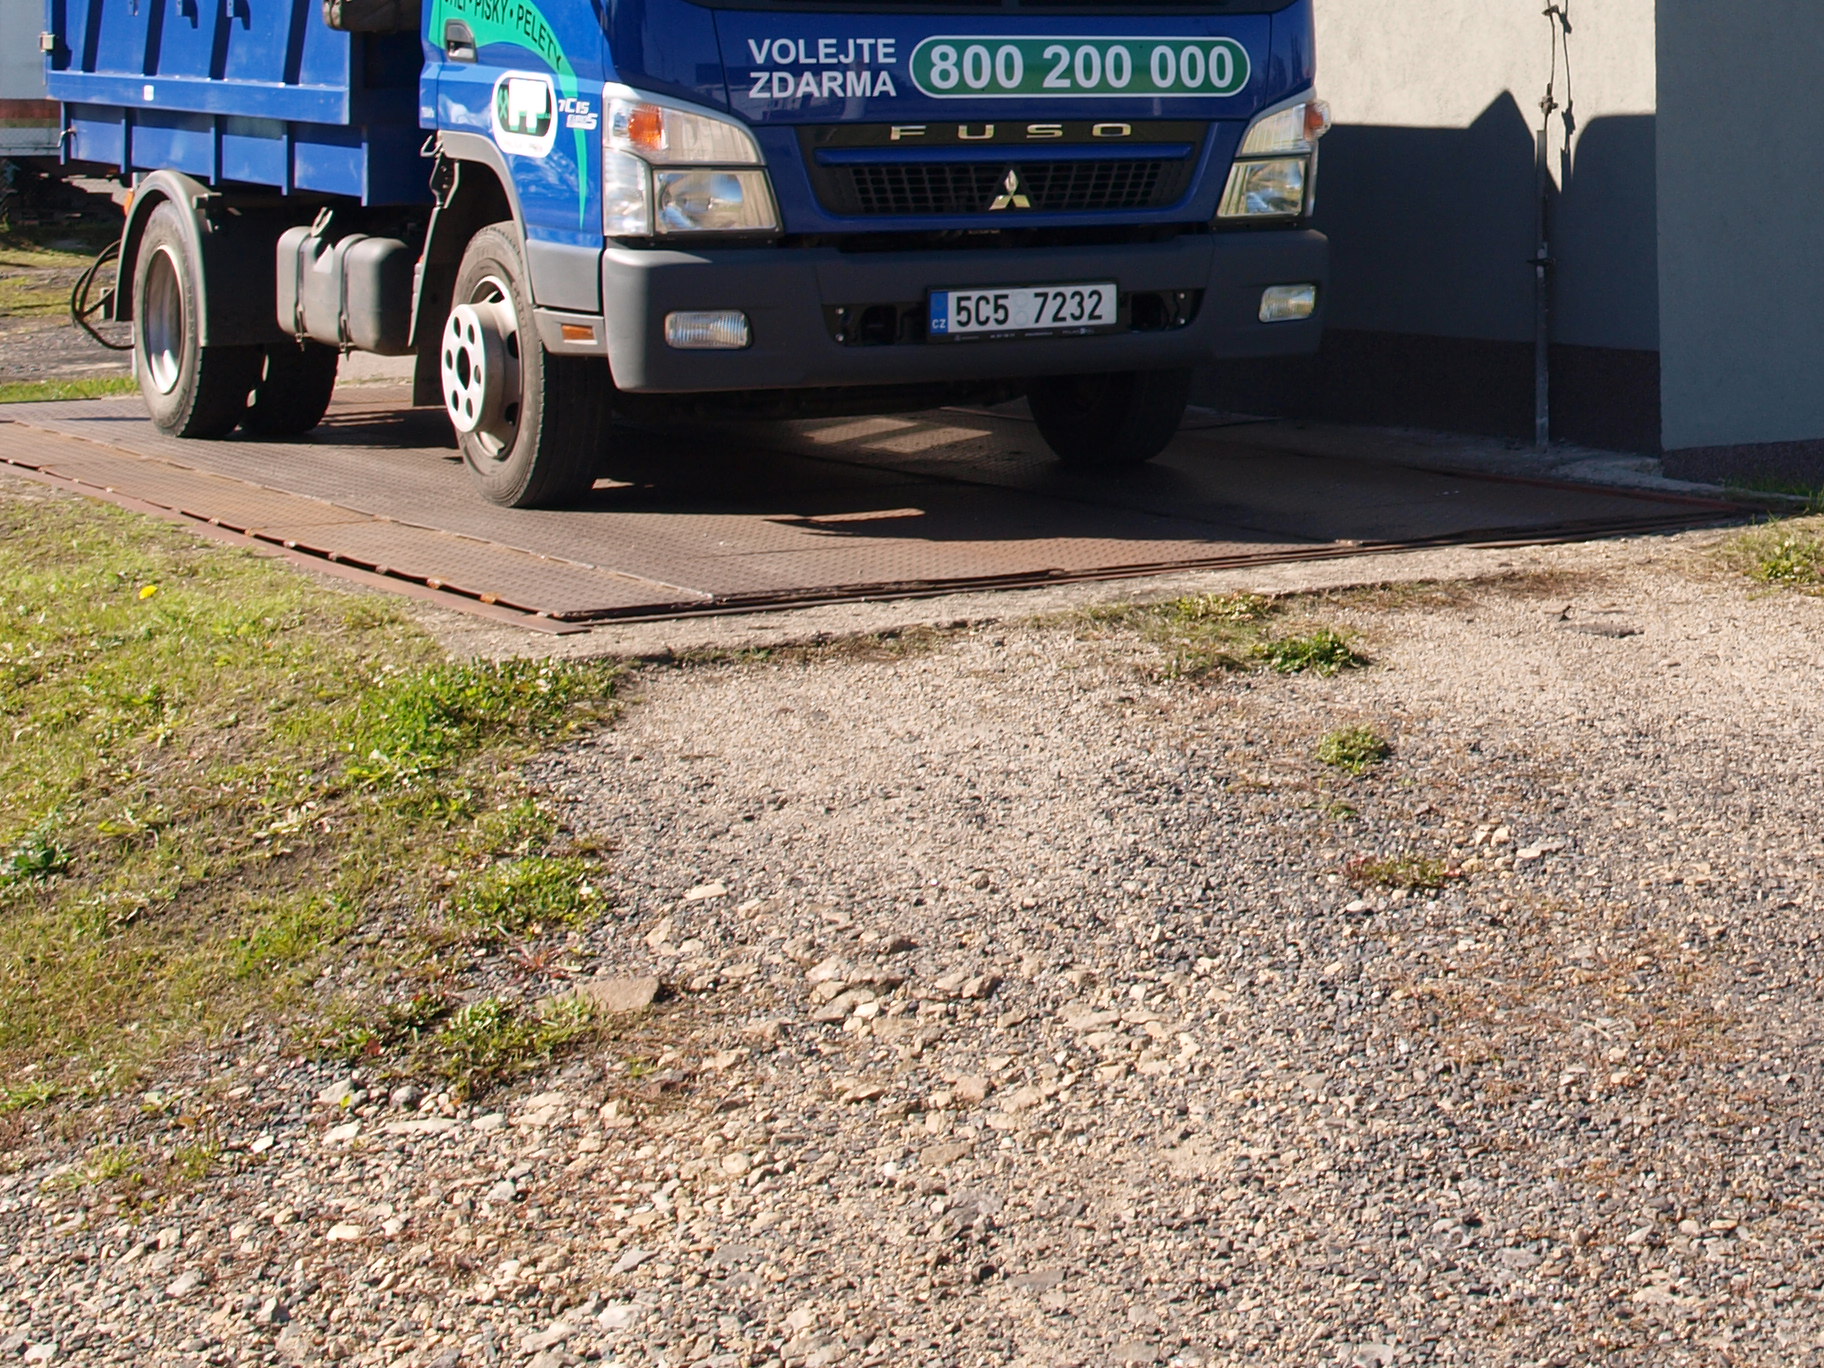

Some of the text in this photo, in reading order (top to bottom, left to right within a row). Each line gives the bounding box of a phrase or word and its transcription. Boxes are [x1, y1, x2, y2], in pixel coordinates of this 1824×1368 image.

[516, 4, 563, 70] PELETY
[748, 38, 897, 65] VOLEJTE
[929, 44, 1235, 90] 800 200 000
[748, 70, 897, 98] ZDARMA
[890, 122, 1132, 141] FUSO
[956, 289, 1103, 328] 5C5 7232
[932, 318, 946, 329] CZ
